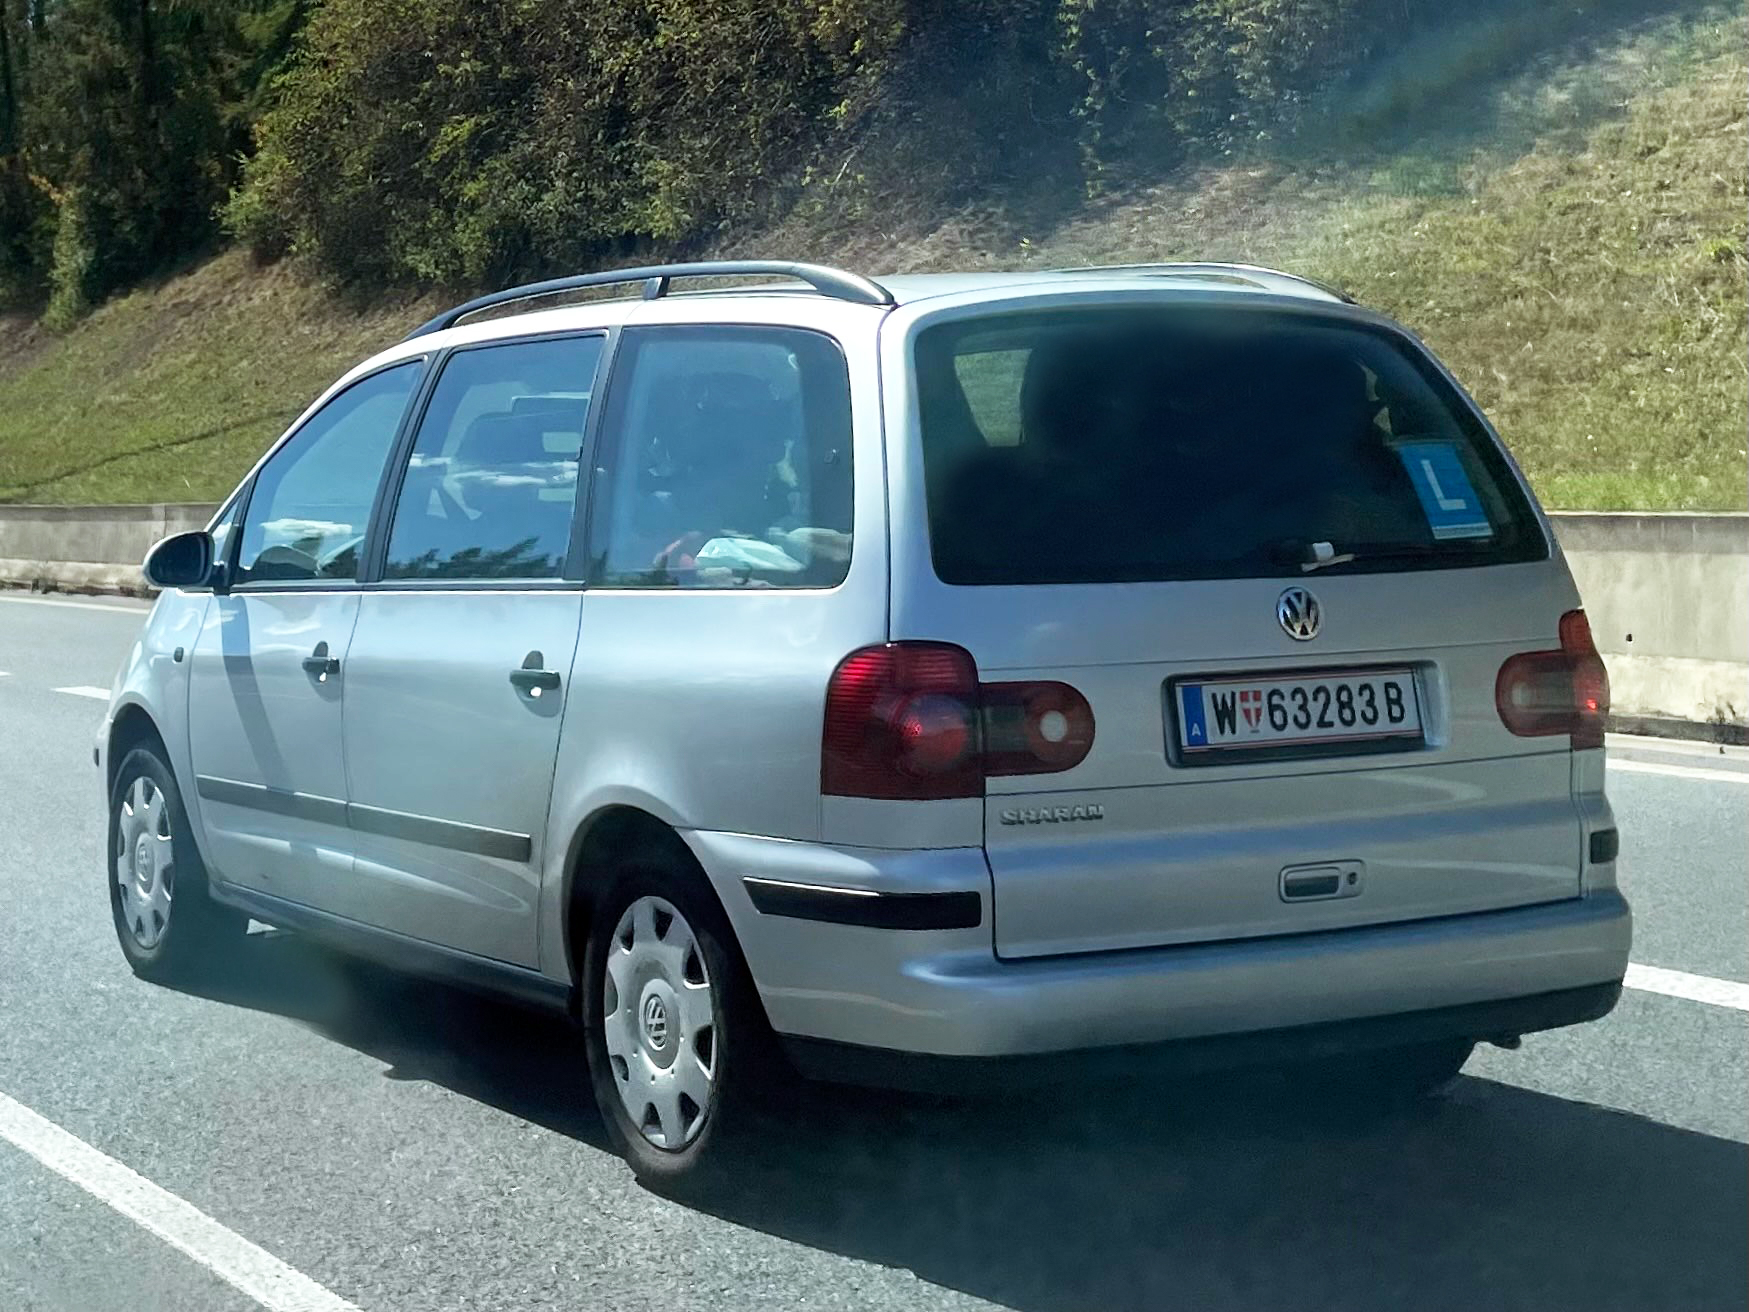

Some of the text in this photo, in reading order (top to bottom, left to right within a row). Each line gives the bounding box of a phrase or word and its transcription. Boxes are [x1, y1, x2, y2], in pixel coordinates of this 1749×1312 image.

[1421, 459, 1467, 511] L
[1211, 690, 1237, 735] W
[1191, 726, 1201, 736] A
[1001, 804, 1104, 825] SHARAN
